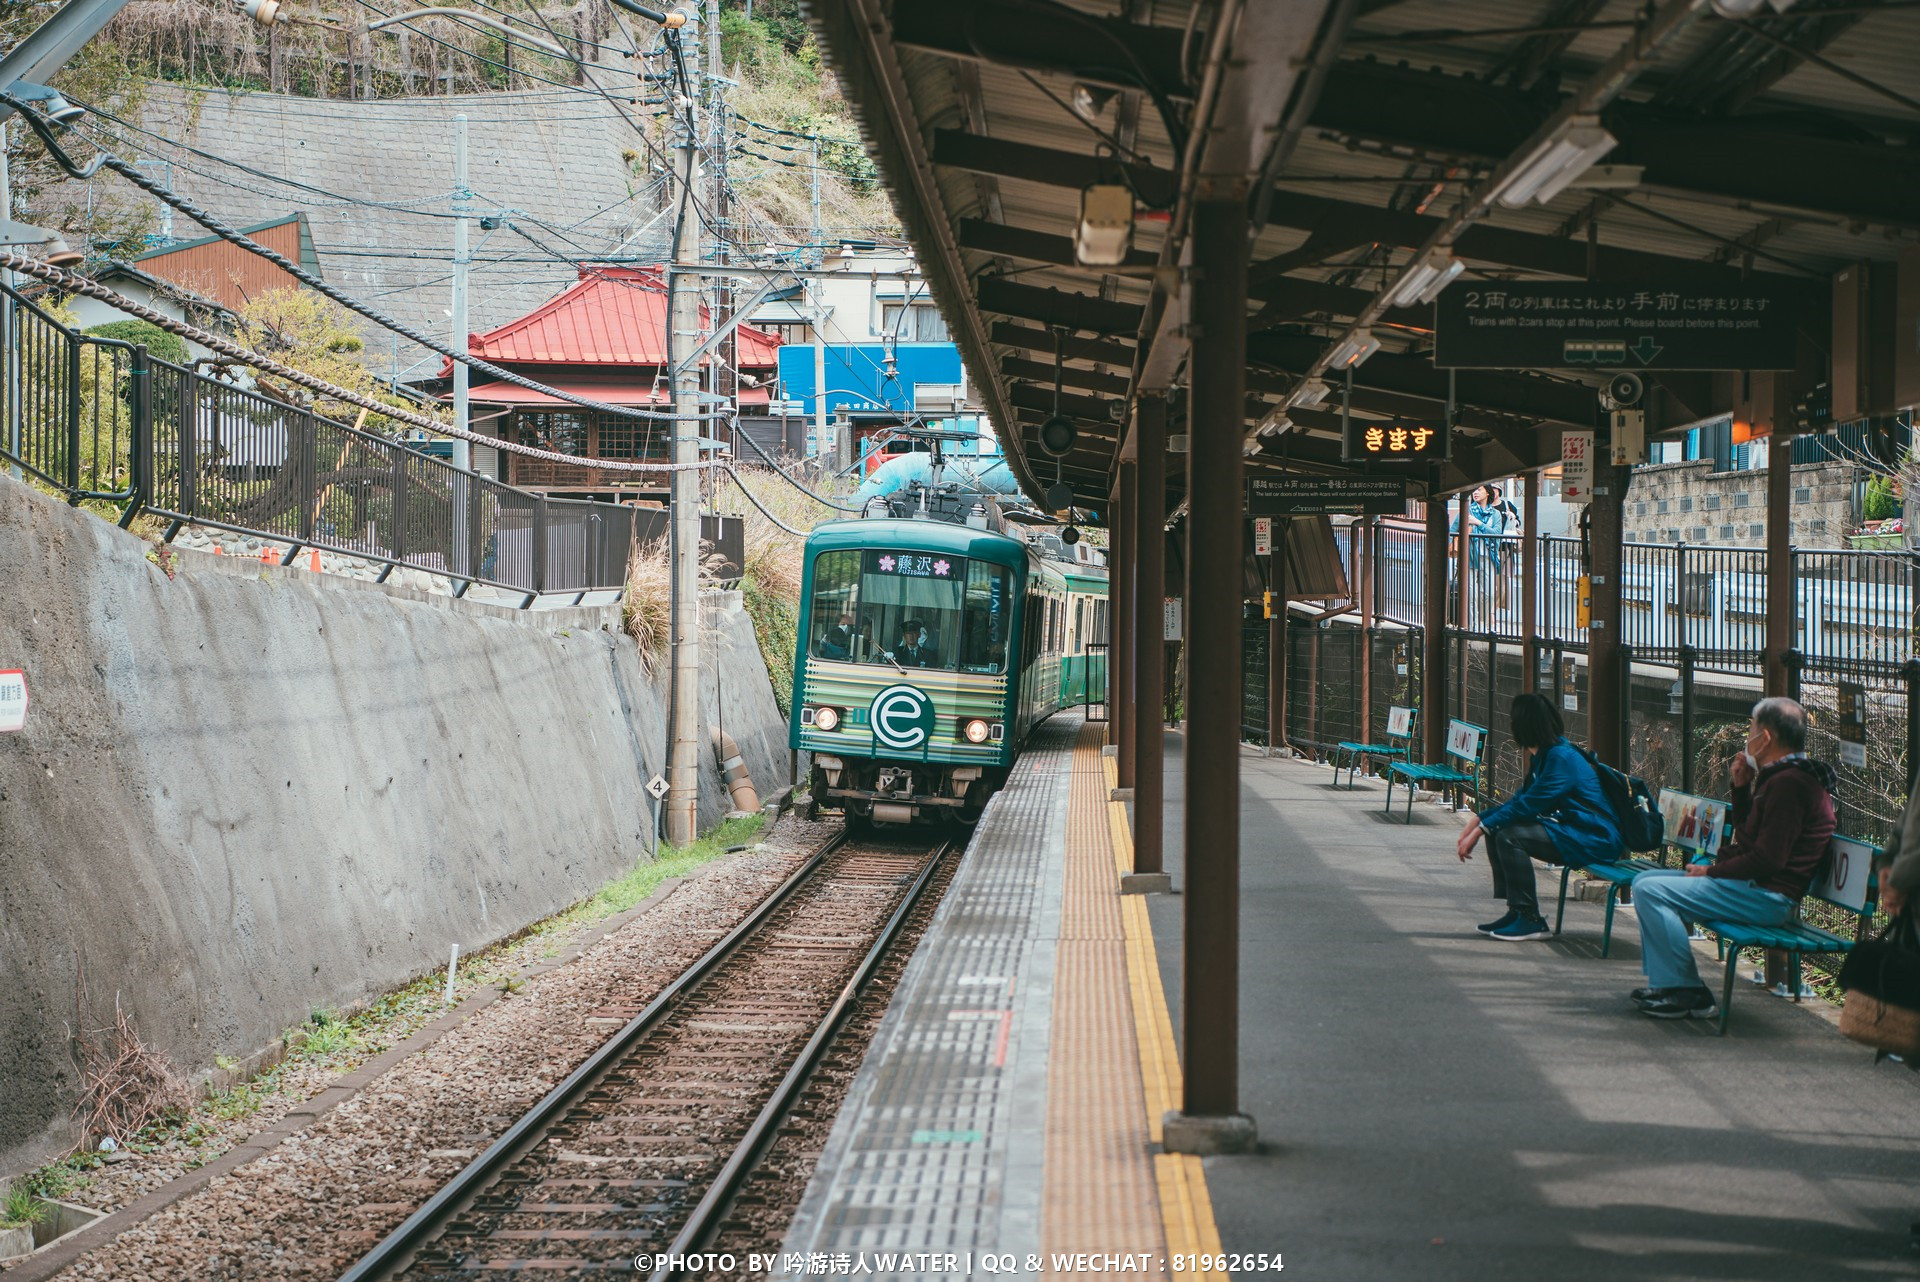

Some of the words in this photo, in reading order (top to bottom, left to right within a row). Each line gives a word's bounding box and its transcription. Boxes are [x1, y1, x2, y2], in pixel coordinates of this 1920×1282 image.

[1465, 291, 1770, 311] 2両の列車はこれより手前に停まります
[1469, 316, 1496, 327] Trains
[1498, 316, 1517, 327] with
[1546, 317, 1566, 329] stop
[1567, 317, 1576, 327] at
[1578, 317, 1595, 327] this
[1596, 317, 1621, 330] point.
[1624, 317, 1655, 328] Please
[1657, 317, 1684, 328] board
[1686, 318, 1716, 328] before
[1717, 318, 1734, 328] this
[1736, 318, 1761, 330] point.
[1365, 427, 1433, 451] きます
[897, 555, 932, 572] 藤沢
[653, 780, 662, 792] 4
